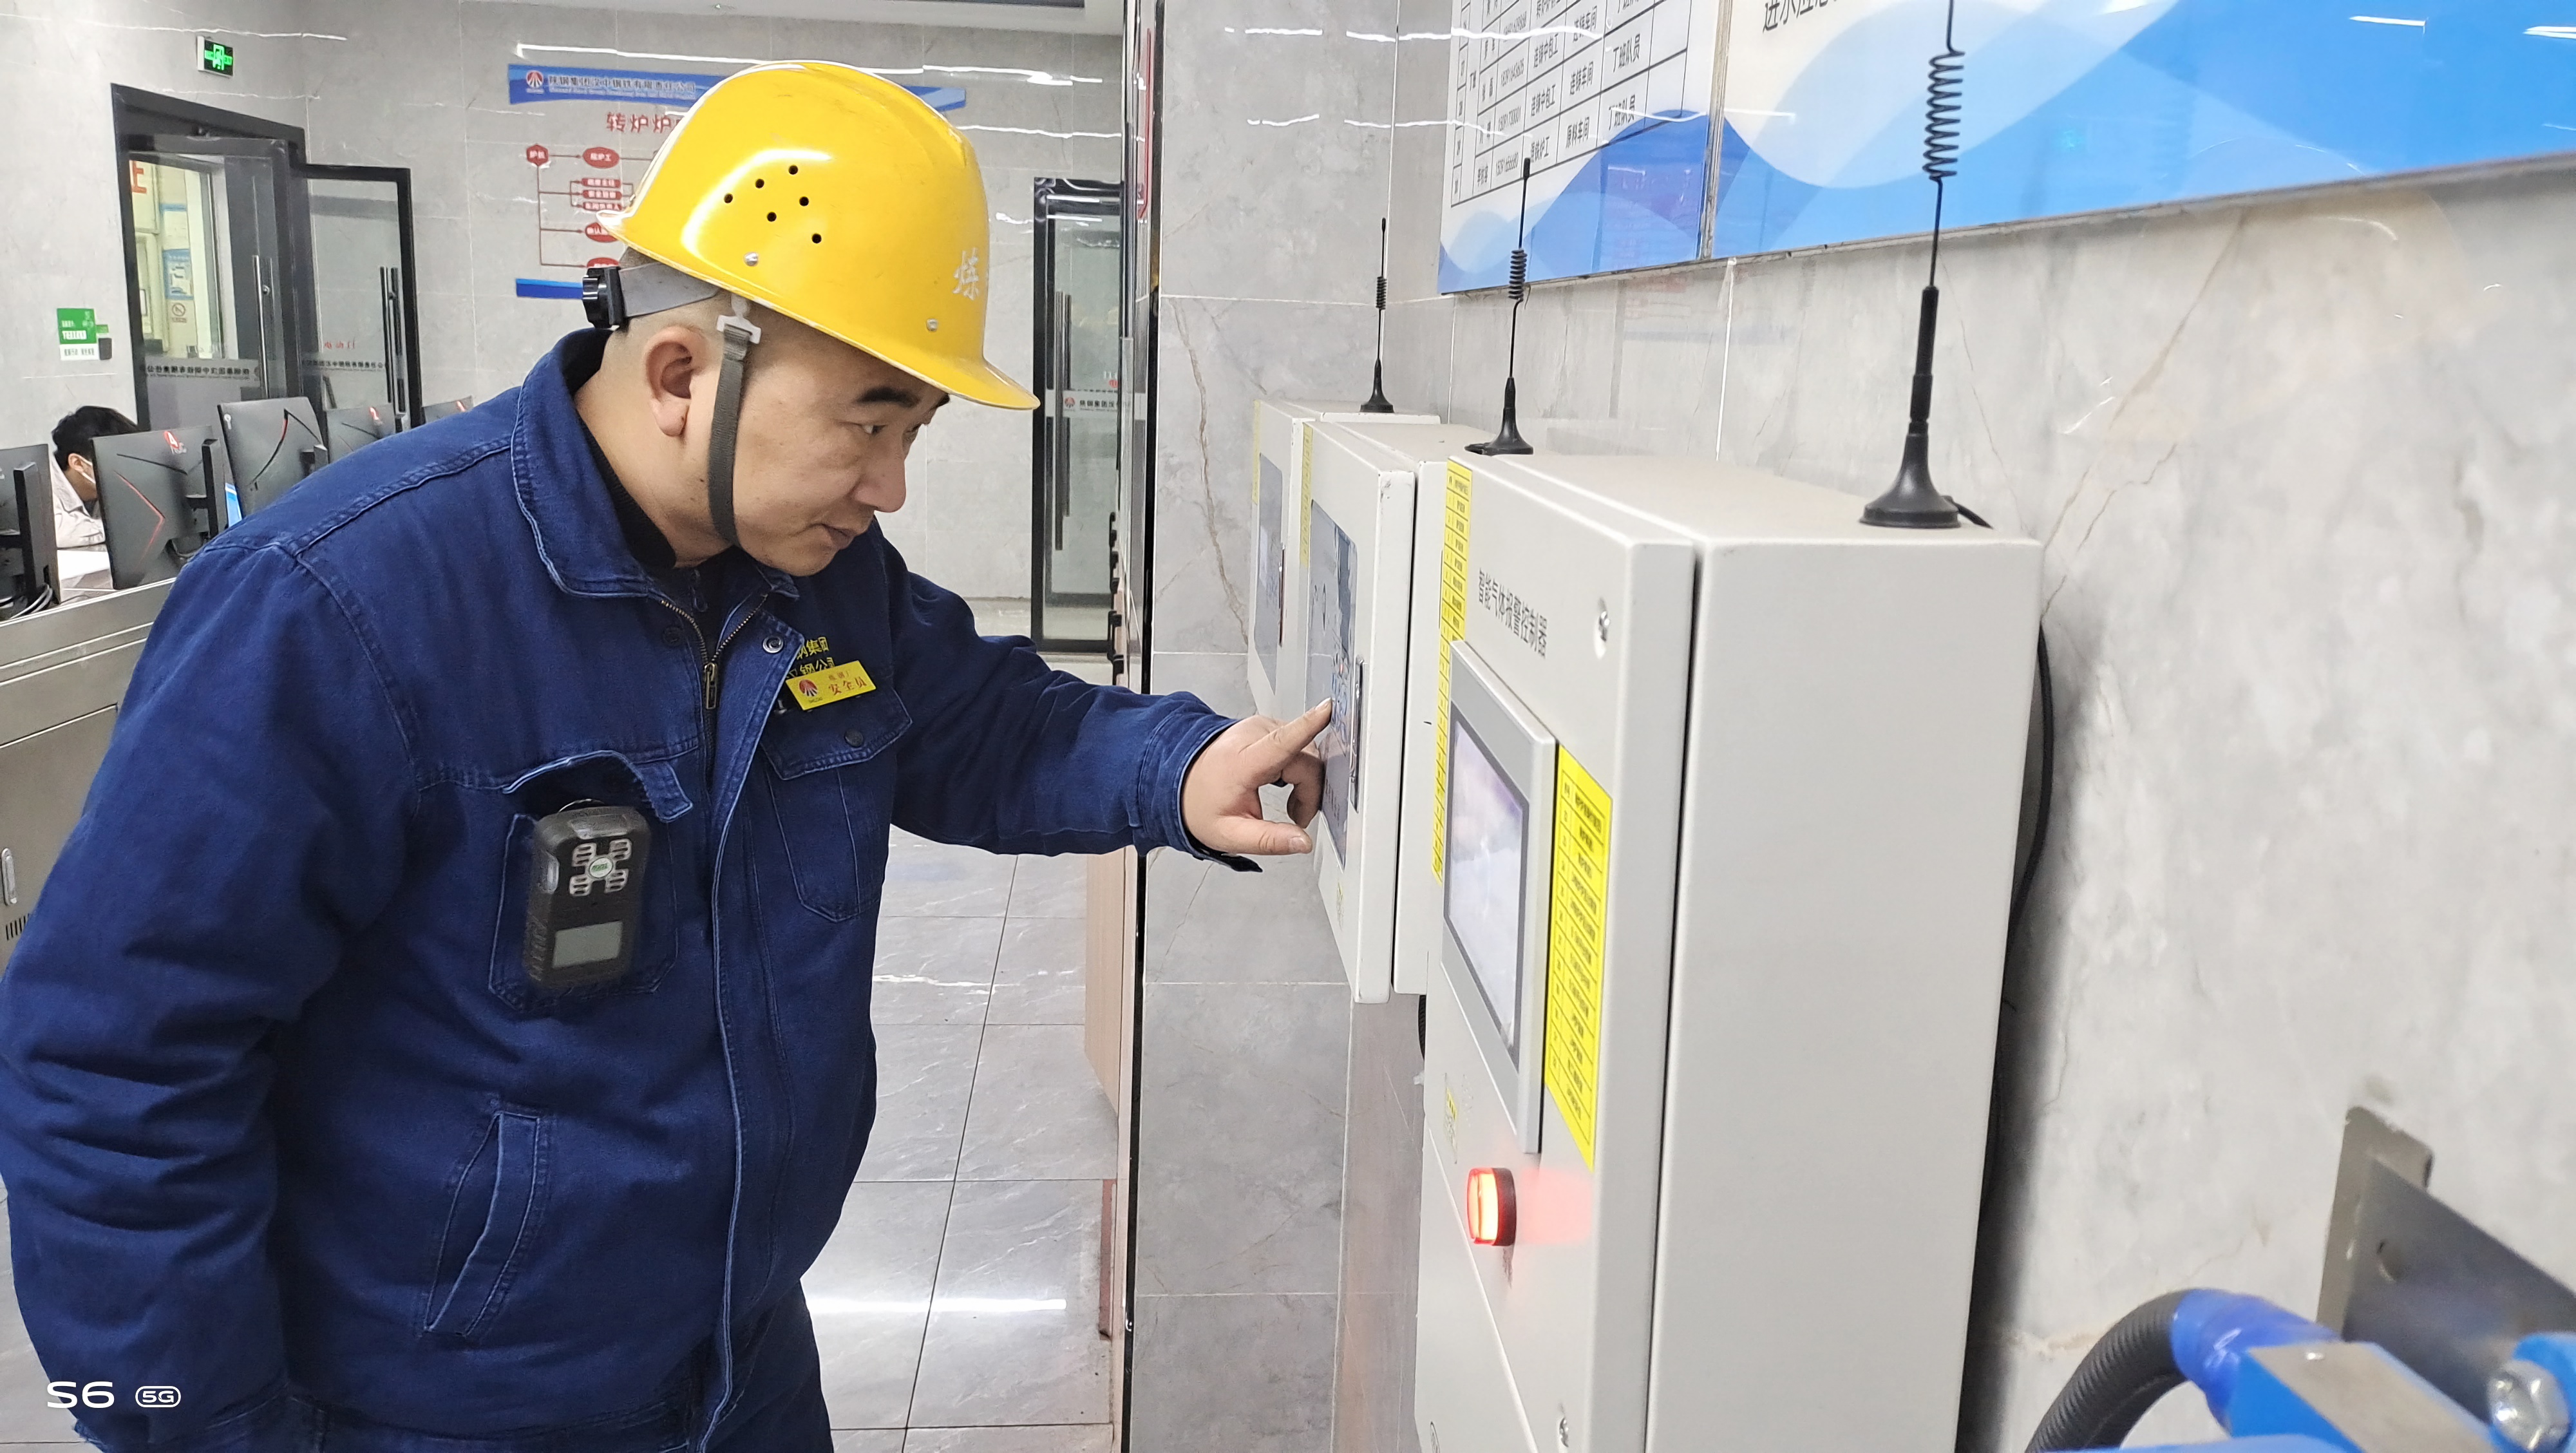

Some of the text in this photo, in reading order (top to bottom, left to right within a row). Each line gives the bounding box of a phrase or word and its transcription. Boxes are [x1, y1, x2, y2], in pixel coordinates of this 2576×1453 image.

[1613, 33, 1640, 73] 丁班队员
[607, 111, 680, 133] 转炉炉
[1479, 567, 1547, 660] 智能气体报警控制器
[828, 676, 867, 696] 安全员
